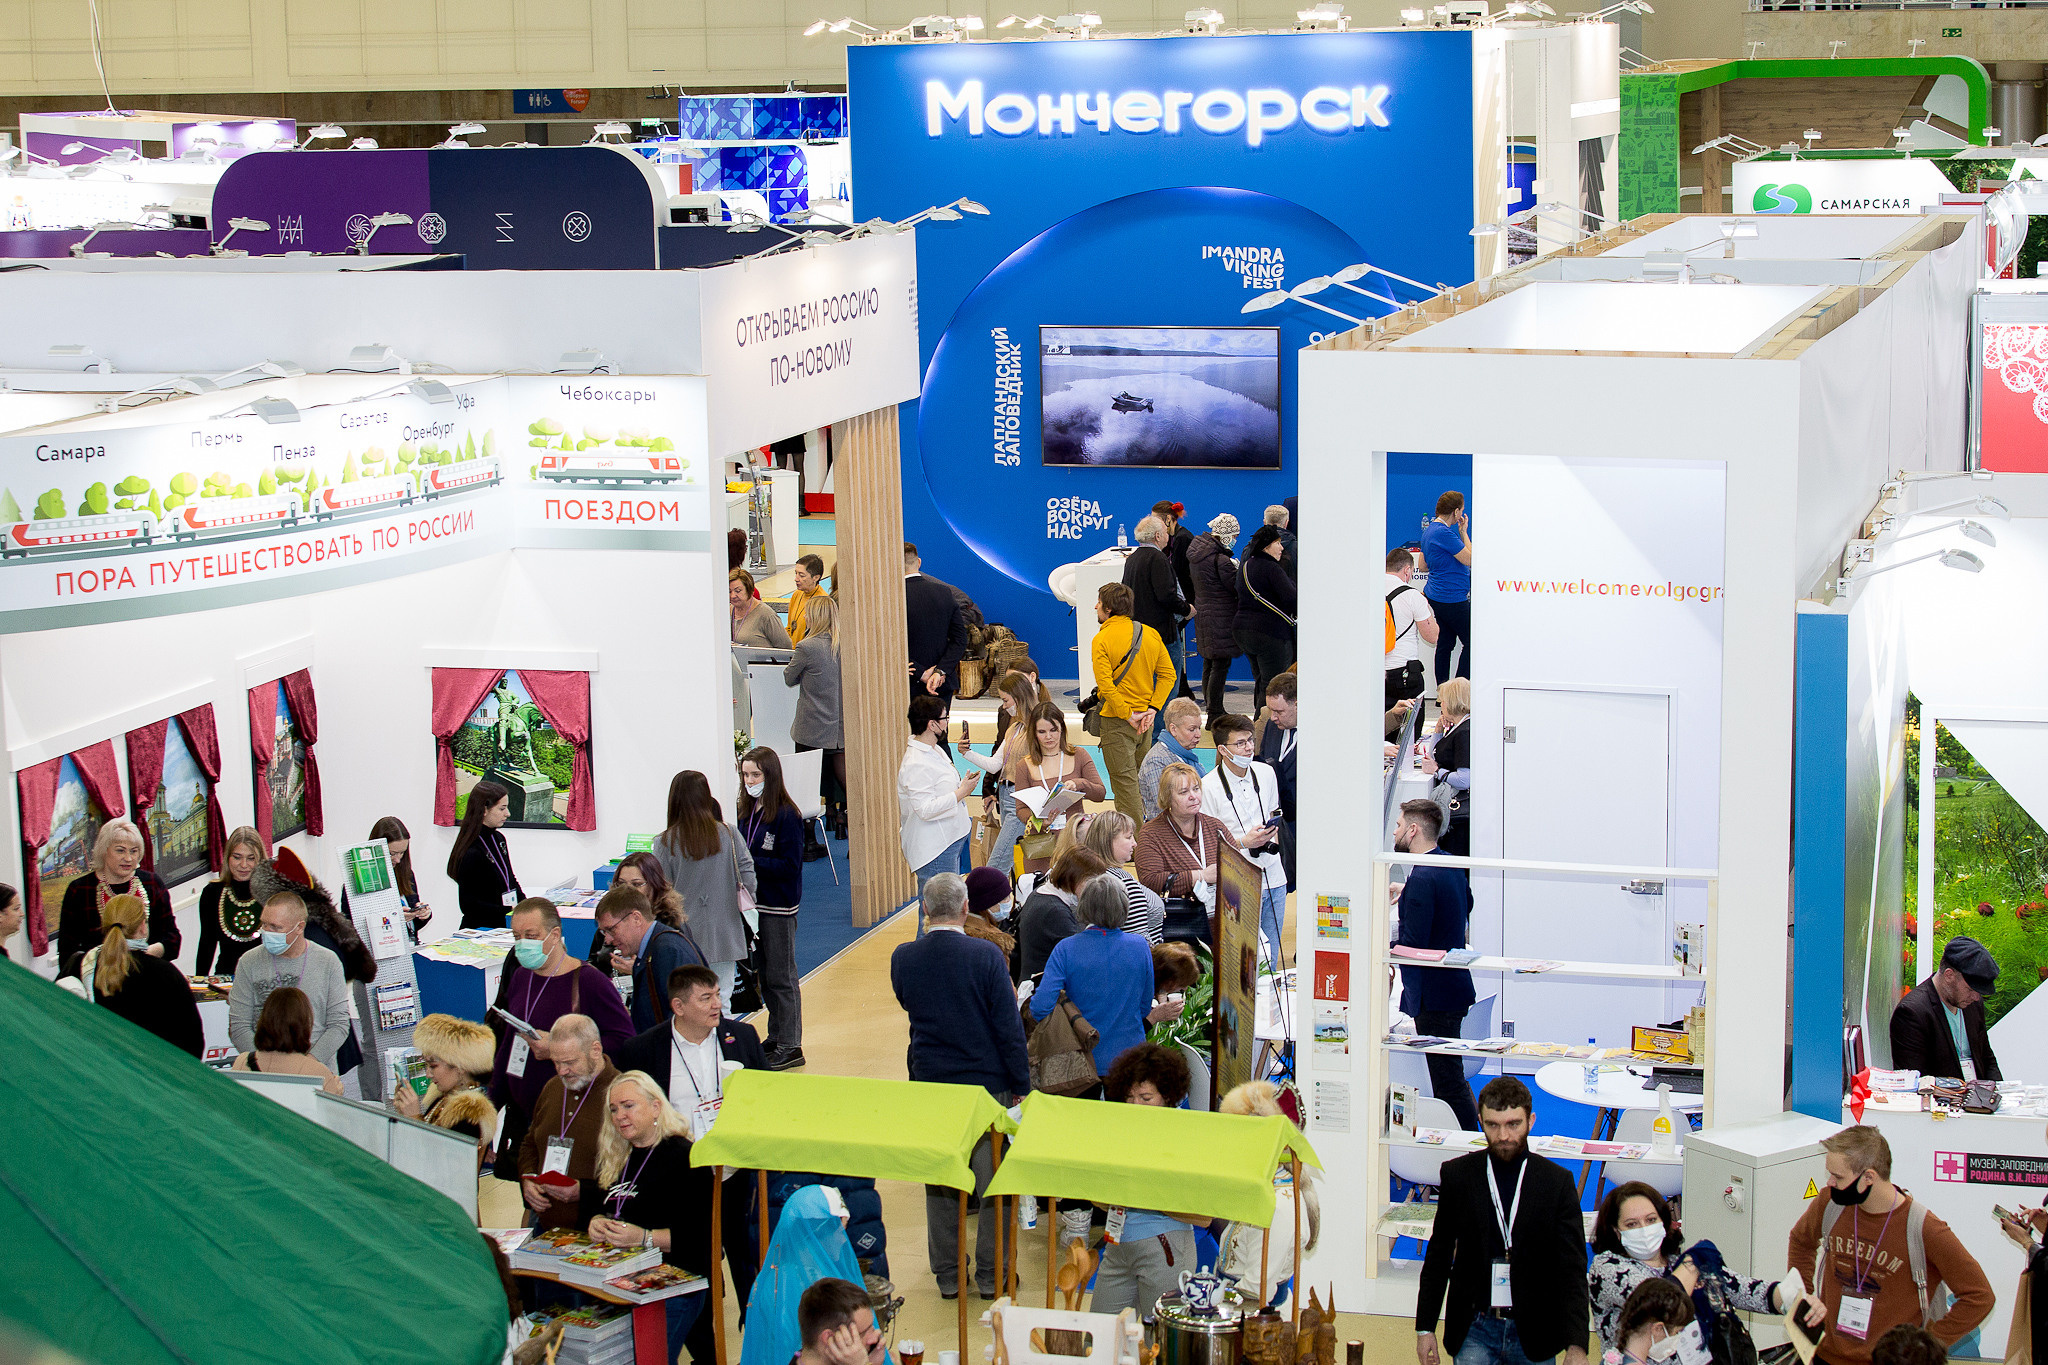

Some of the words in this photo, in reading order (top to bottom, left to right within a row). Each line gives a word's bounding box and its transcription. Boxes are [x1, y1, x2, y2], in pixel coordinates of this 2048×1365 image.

[926, 80, 1390, 146] Мончегорск
[1821, 199, 1910, 210] САМАРСКАЯ
[1202, 245, 1285, 264] IMANDRA
[1222, 257, 1285, 279] VIKING
[1243, 275, 1285, 290] FEST
[736, 300, 820, 348] ОТКРЫВАЕМ
[822, 287, 879, 327] РОССИЮ
[770, 337, 853, 387] ПО-НОВОМУ
[456, 393, 476, 412] Уфа
[560, 385, 656, 405] Чебоксары
[990, 327, 1011, 467] ЛАПЛАНДСКИЙ
[1005, 343, 1024, 467] ЗАПОВЕДНИК
[340, 411, 389, 430] Саратов
[191, 431, 244, 449] Пермь
[403, 421, 456, 444] Оренбург
[36, 444, 106, 463] Самара
[273, 444, 317, 462] Пенза
[545, 499, 680, 525] ПОЕЗДОМ
[1046, 495, 1103, 517] ОЗЁРА
[1047, 508, 1114, 531] ВОКРУГ
[1047, 522, 1083, 540] НАС
[56, 566, 136, 596] ПОРА
[149, 533, 363, 586] ПУТЕШЕСТВОВАТЬ
[372, 525, 400, 553] ПО
[408, 509, 475, 545] РОССИИ
[1496, 578, 1725, 603] www.welcomevolgogr
[1970, 1170, 2006, 1182] РОДИНА
[2025, 1173, 2048, 1184] ЛЕНИ
